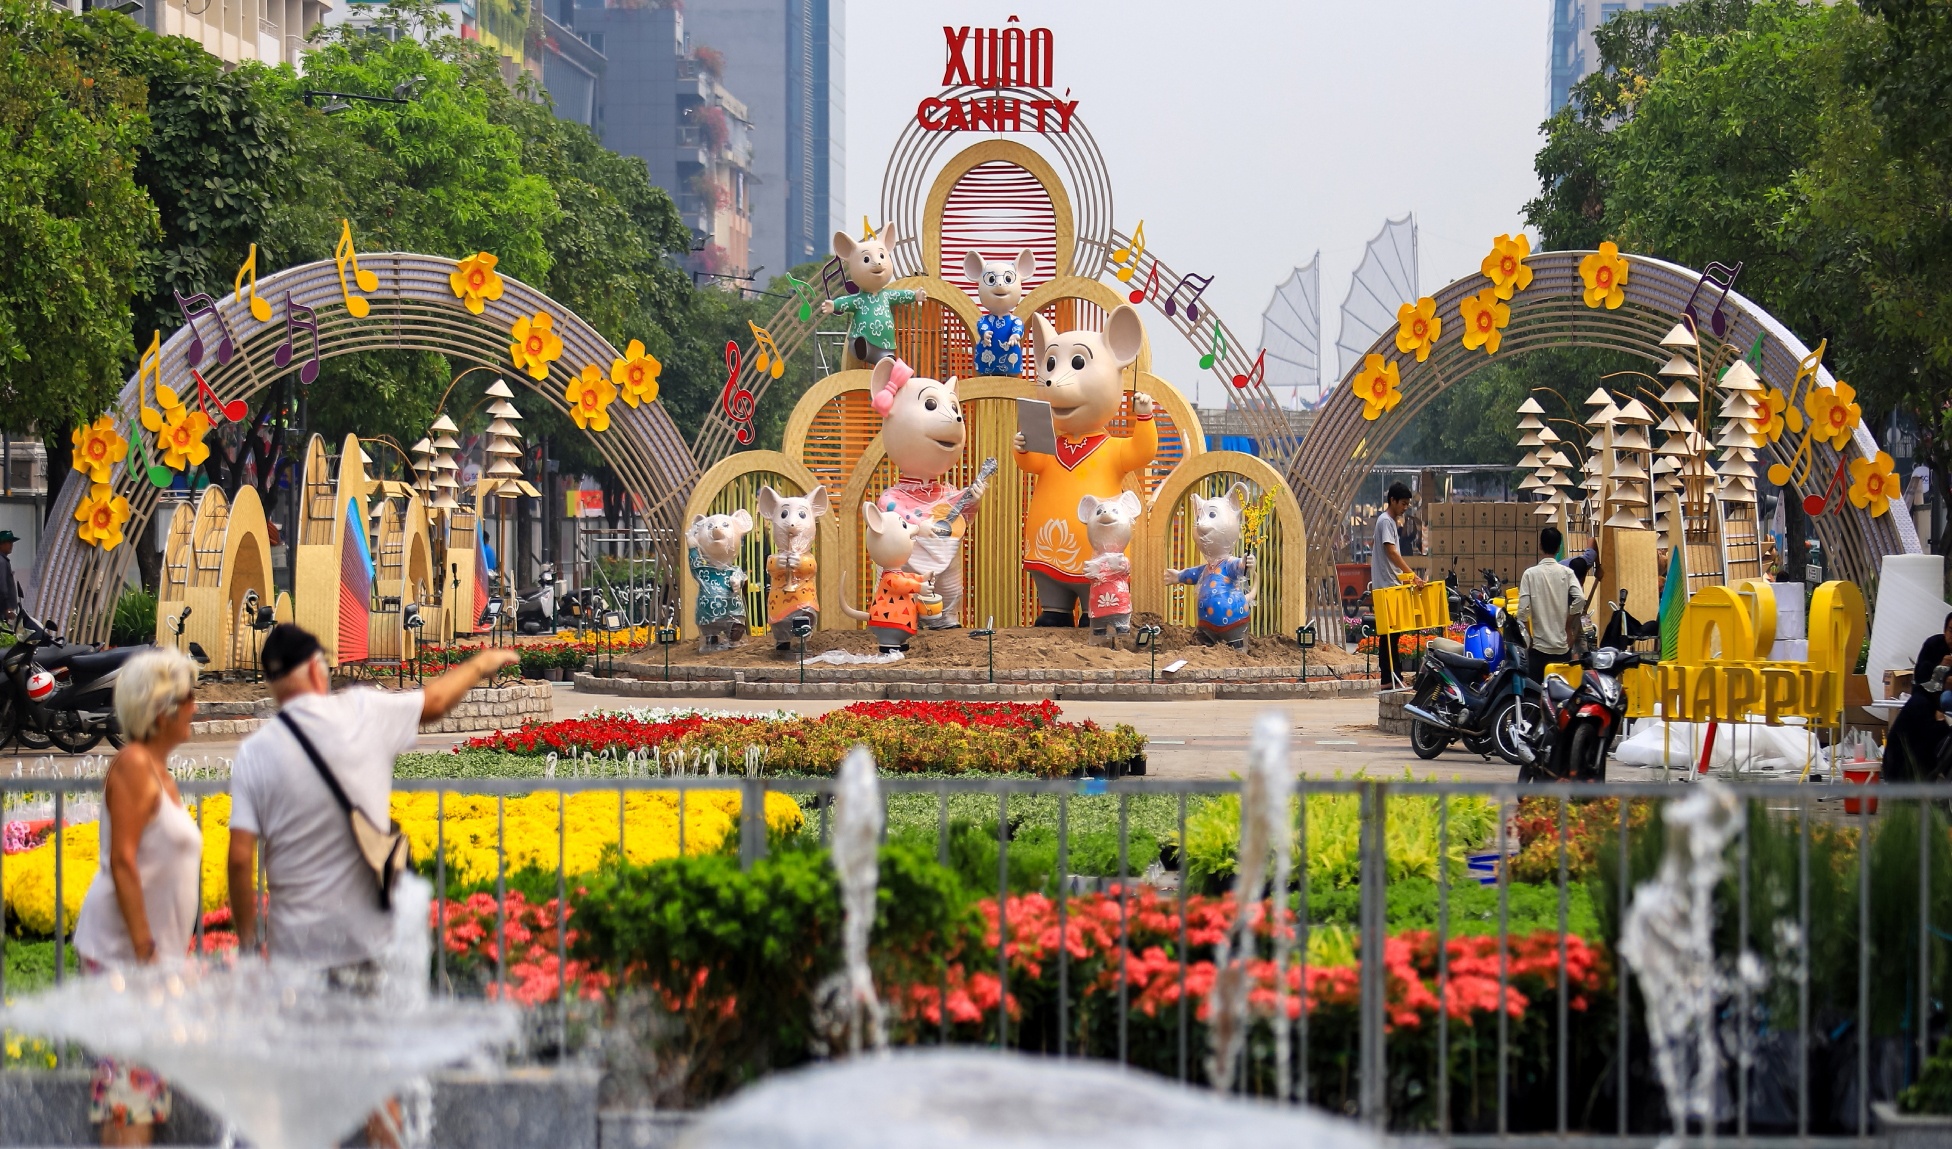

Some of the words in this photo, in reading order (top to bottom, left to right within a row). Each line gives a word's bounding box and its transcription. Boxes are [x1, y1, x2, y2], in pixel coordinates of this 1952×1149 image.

[941, 15, 1054, 89] XUÂN
[917, 97, 1021, 133] CANH
[1030, 87, 1079, 133] TÝ
[1657, 664, 1840, 728] HAPPY
